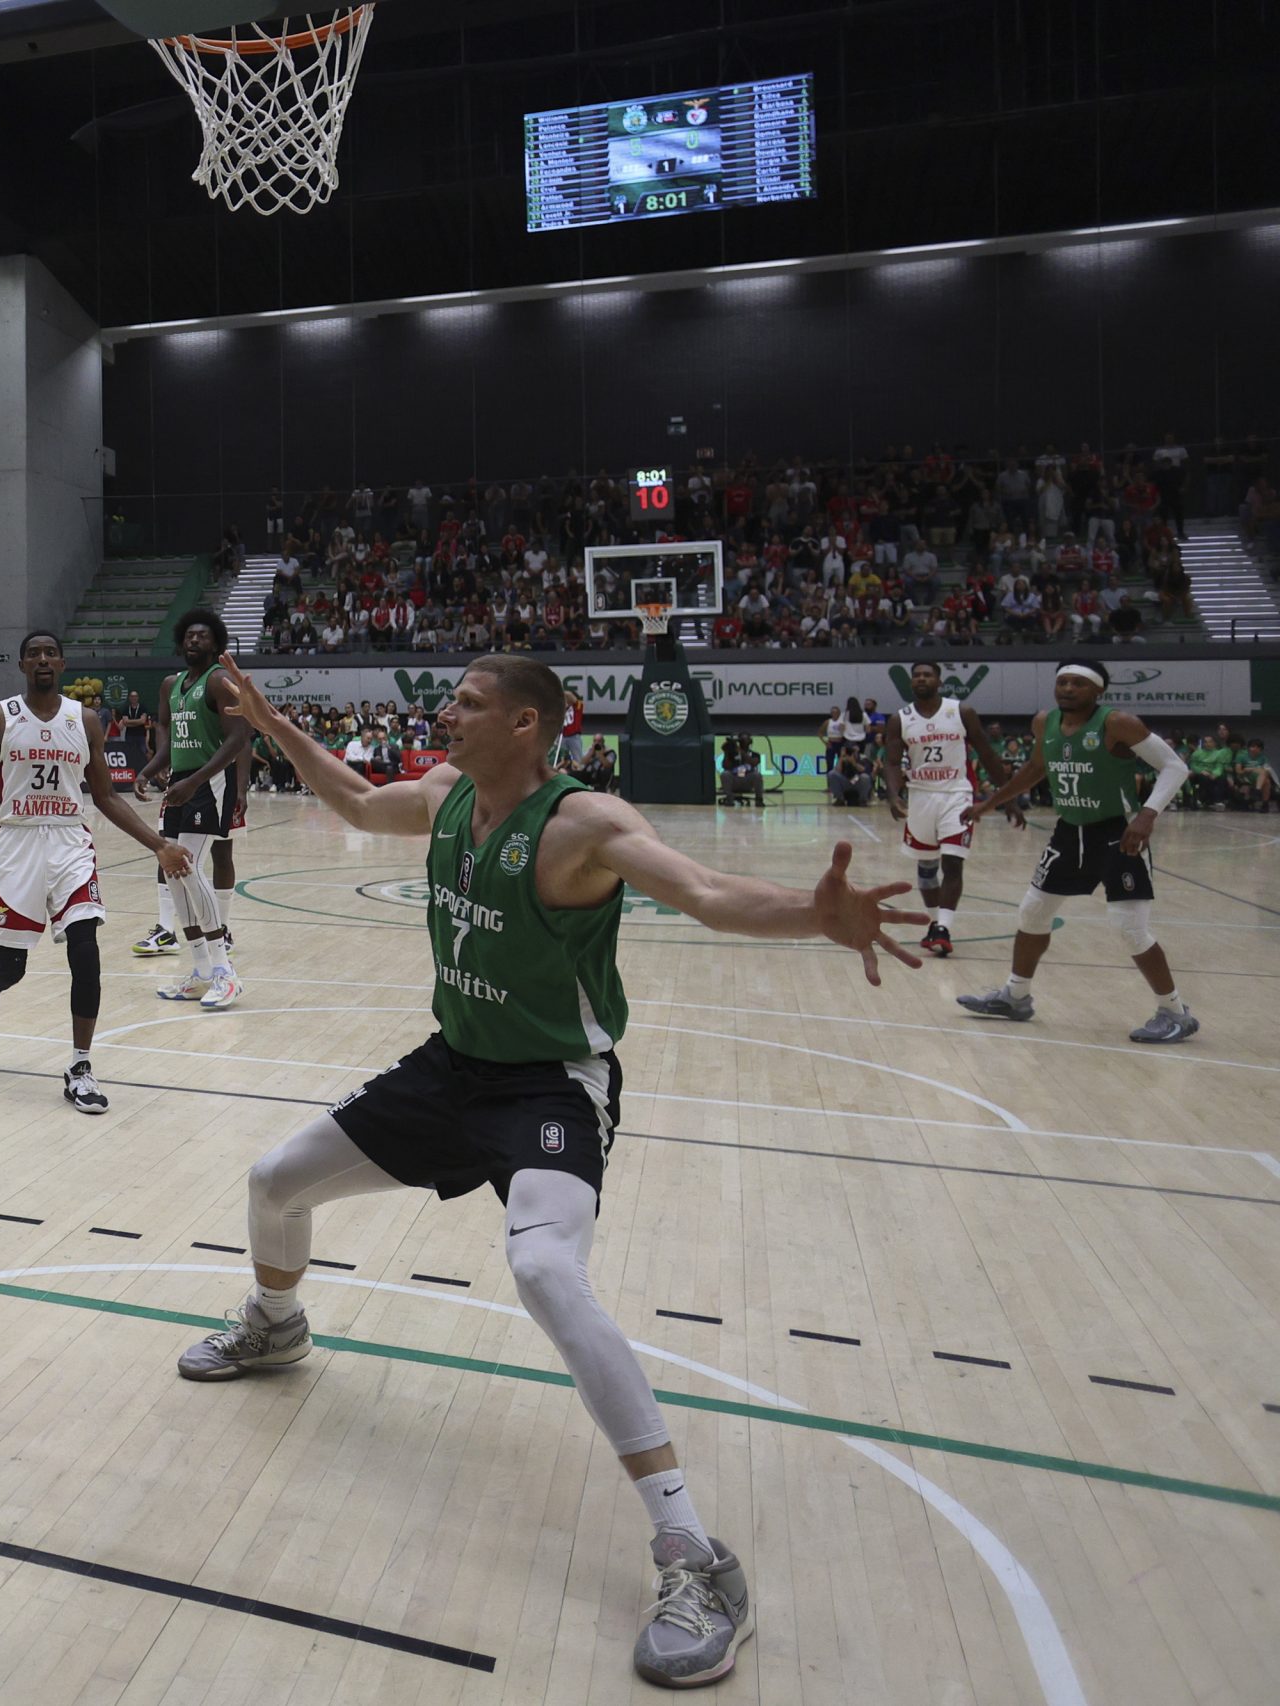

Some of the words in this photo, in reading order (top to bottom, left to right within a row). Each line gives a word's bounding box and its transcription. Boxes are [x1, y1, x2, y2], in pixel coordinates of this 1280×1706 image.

[686, 130, 698, 149] 0
[663, 161, 669, 172] 1
[646, 192, 687, 210] 8:01
[636, 469, 667, 482] 8:01
[635, 485, 670, 510] 10
[650, 680, 682, 693] SCP
[728, 682, 833, 696] MACOFREI
[286, 694, 331, 702] PARTNER
[1136, 692, 1206, 701] PARTNER
[176, 721, 189, 739] 30
[9, 750, 26, 762] SL
[28, 749, 81, 765] BENFICA
[923, 746, 943, 763] 23
[1048, 761, 1094, 773] SPORTING
[31, 764, 60, 791] 34
[1058, 773, 1080, 796] 57
[26, 794, 72, 803] conservas
[12, 799, 78, 817] RAMIREZ
[511, 832, 530, 842] SCP
[434, 883, 504, 932] SPORTING
[451, 916, 471, 967] 7
